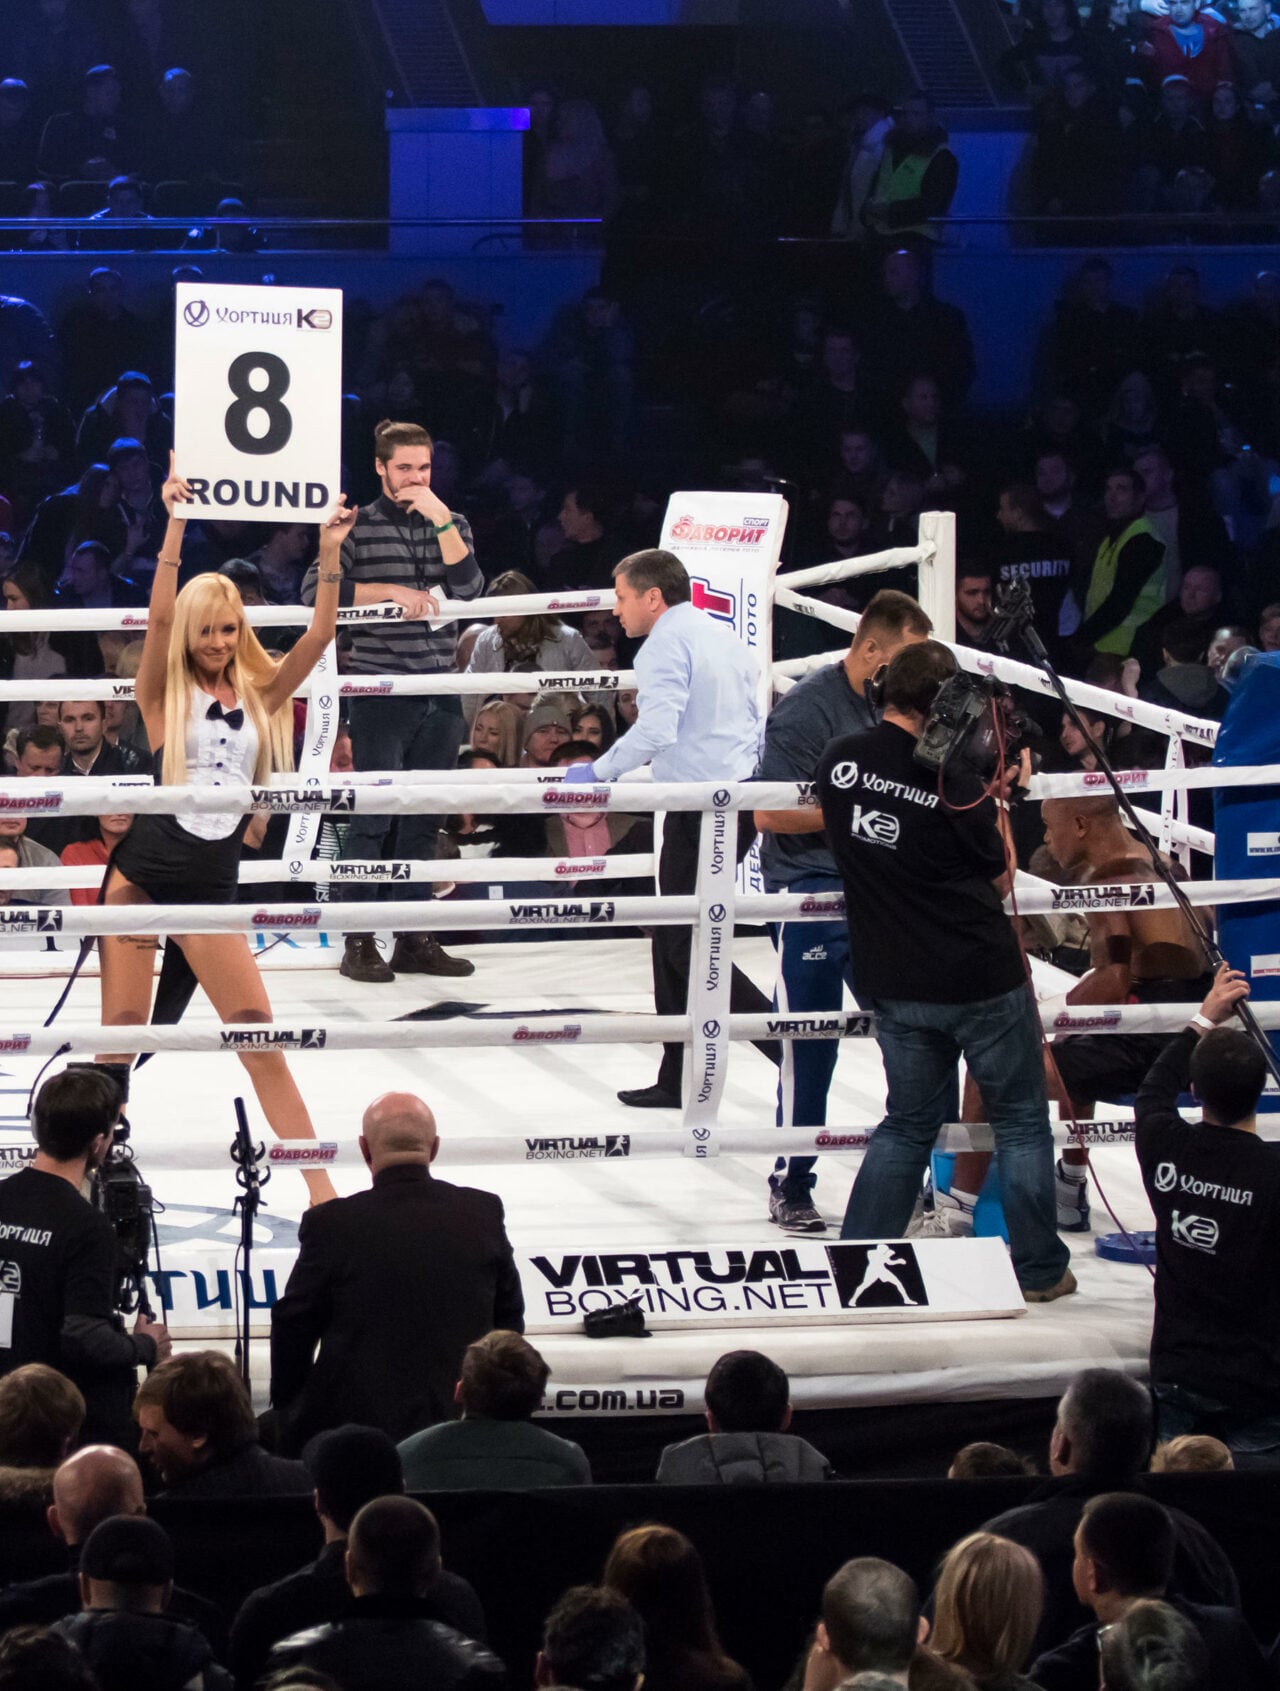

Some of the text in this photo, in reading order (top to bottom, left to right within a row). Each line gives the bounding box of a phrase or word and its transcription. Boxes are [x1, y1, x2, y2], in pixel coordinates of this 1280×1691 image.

[225, 351, 293, 455] 8
[186, 478, 330, 509] ROUND
[1000, 560, 1070, 580] SECURITY
[337, 609, 383, 619] RTUAL
[538, 677, 600, 689] VIRTUAL
[1083, 772, 1149, 786] ФАОРИТ
[251, 790, 330, 803] VIRTUAL
[251, 801, 330, 811] BOXING.NET
[851, 804, 900, 843] K2
[330, 863, 392, 876] VIRTUAL
[1051, 885, 1130, 901] VIRTUAL
[509, 904, 590, 918] VIRTUAL
[1051, 898, 1130, 910] BOXING.NET
[509, 916, 590, 925] BOXING.NET
[767, 1020, 846, 1034] VIRTUAL
[221, 1030, 301, 1044] VIRTUAL
[1066, 1120, 1136, 1136] VIRTUA
[525, 1137, 606, 1151] VIRTUAL
[815, 1133, 871, 1148] ФАВОР
[1066, 1133, 1136, 1145] BOXING.NE
[526, 1149, 605, 1160] BOXING.NET
[528, 1248, 830, 1289] VIRTUAL
[538, 1389, 685, 1412] .com.ua
